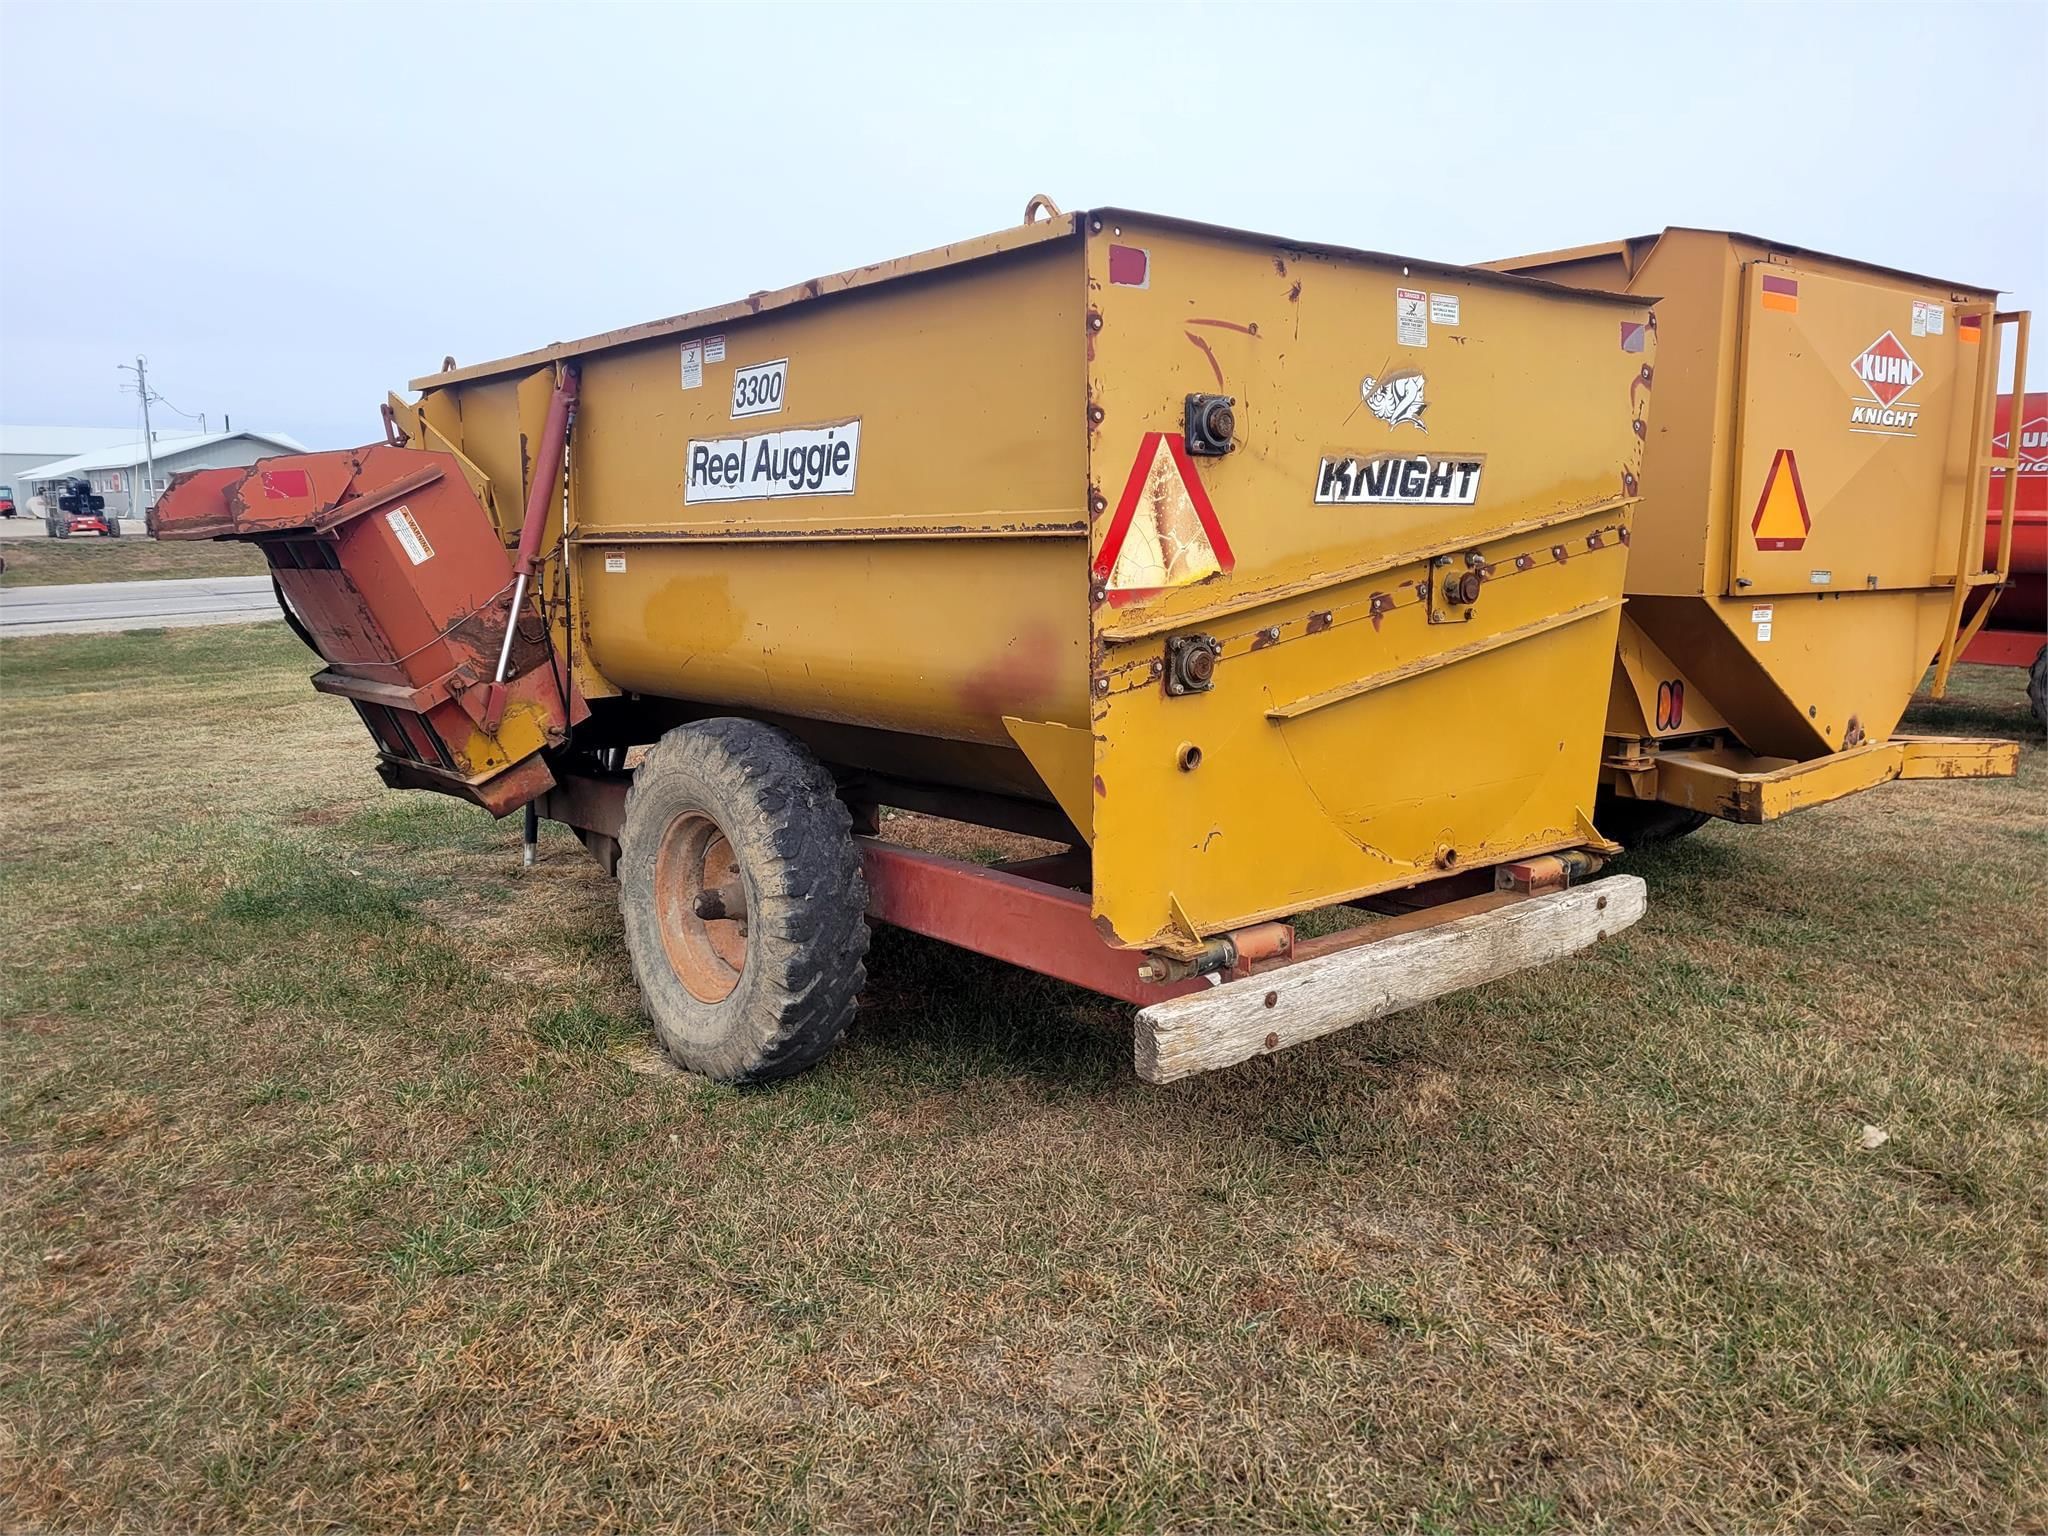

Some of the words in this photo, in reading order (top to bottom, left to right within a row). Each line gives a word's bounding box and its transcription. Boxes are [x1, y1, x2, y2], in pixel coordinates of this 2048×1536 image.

[1862, 353, 1913, 386] KUHN
[735, 371, 782, 409] 3300
[1851, 406, 1918, 428] KNIGHT
[691, 441, 748, 487] Reel
[751, 431, 850, 490] Auggie
[1320, 458, 1482, 499] KNIGHT
[408, 519, 430, 553] WARNING
